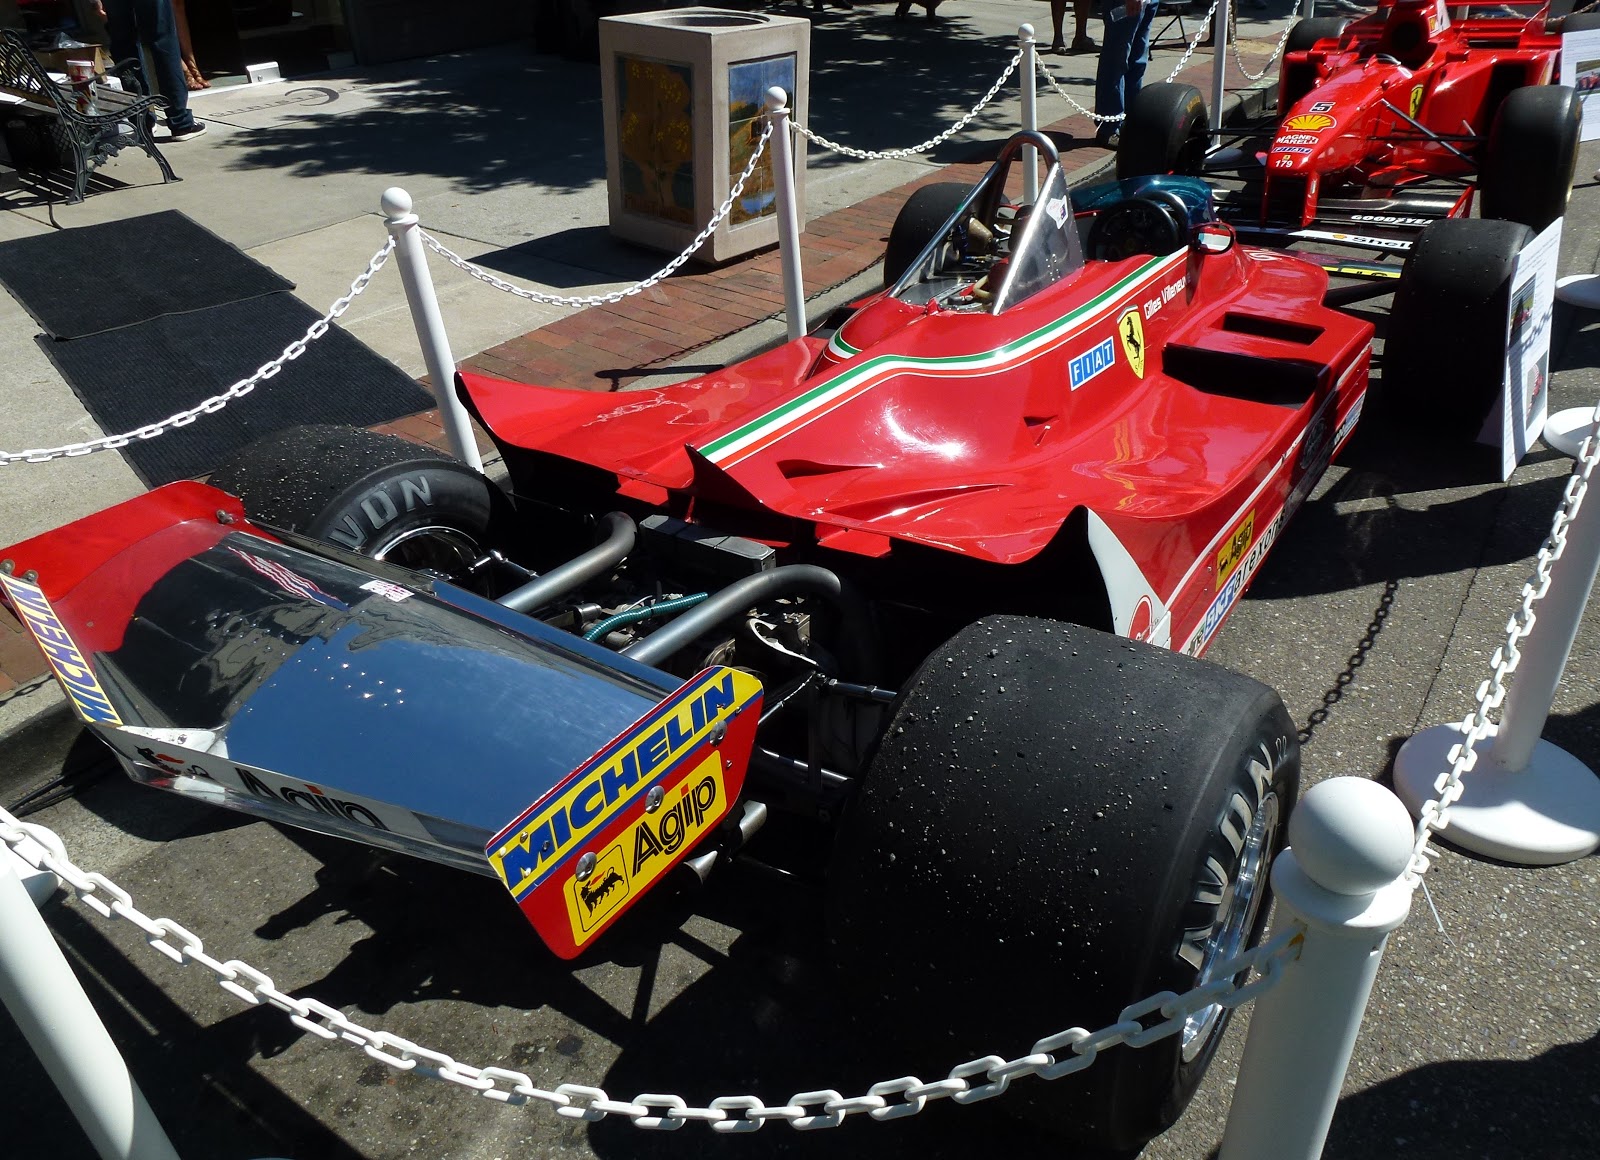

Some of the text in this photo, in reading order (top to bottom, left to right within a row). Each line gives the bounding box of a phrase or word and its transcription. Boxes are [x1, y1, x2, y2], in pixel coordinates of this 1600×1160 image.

[1275, 160, 1293, 168] 179
[1351, 215, 1433, 225] GOODYEA
[1073, 343, 1111, 382] FIAT
[329, 475, 433, 551] VON
[1204, 577, 1237, 637] SKF
[9, 580, 115, 722] MICHELIN
[502, 672, 735, 890] MICHELIN
[631, 775, 716, 878] Agip
